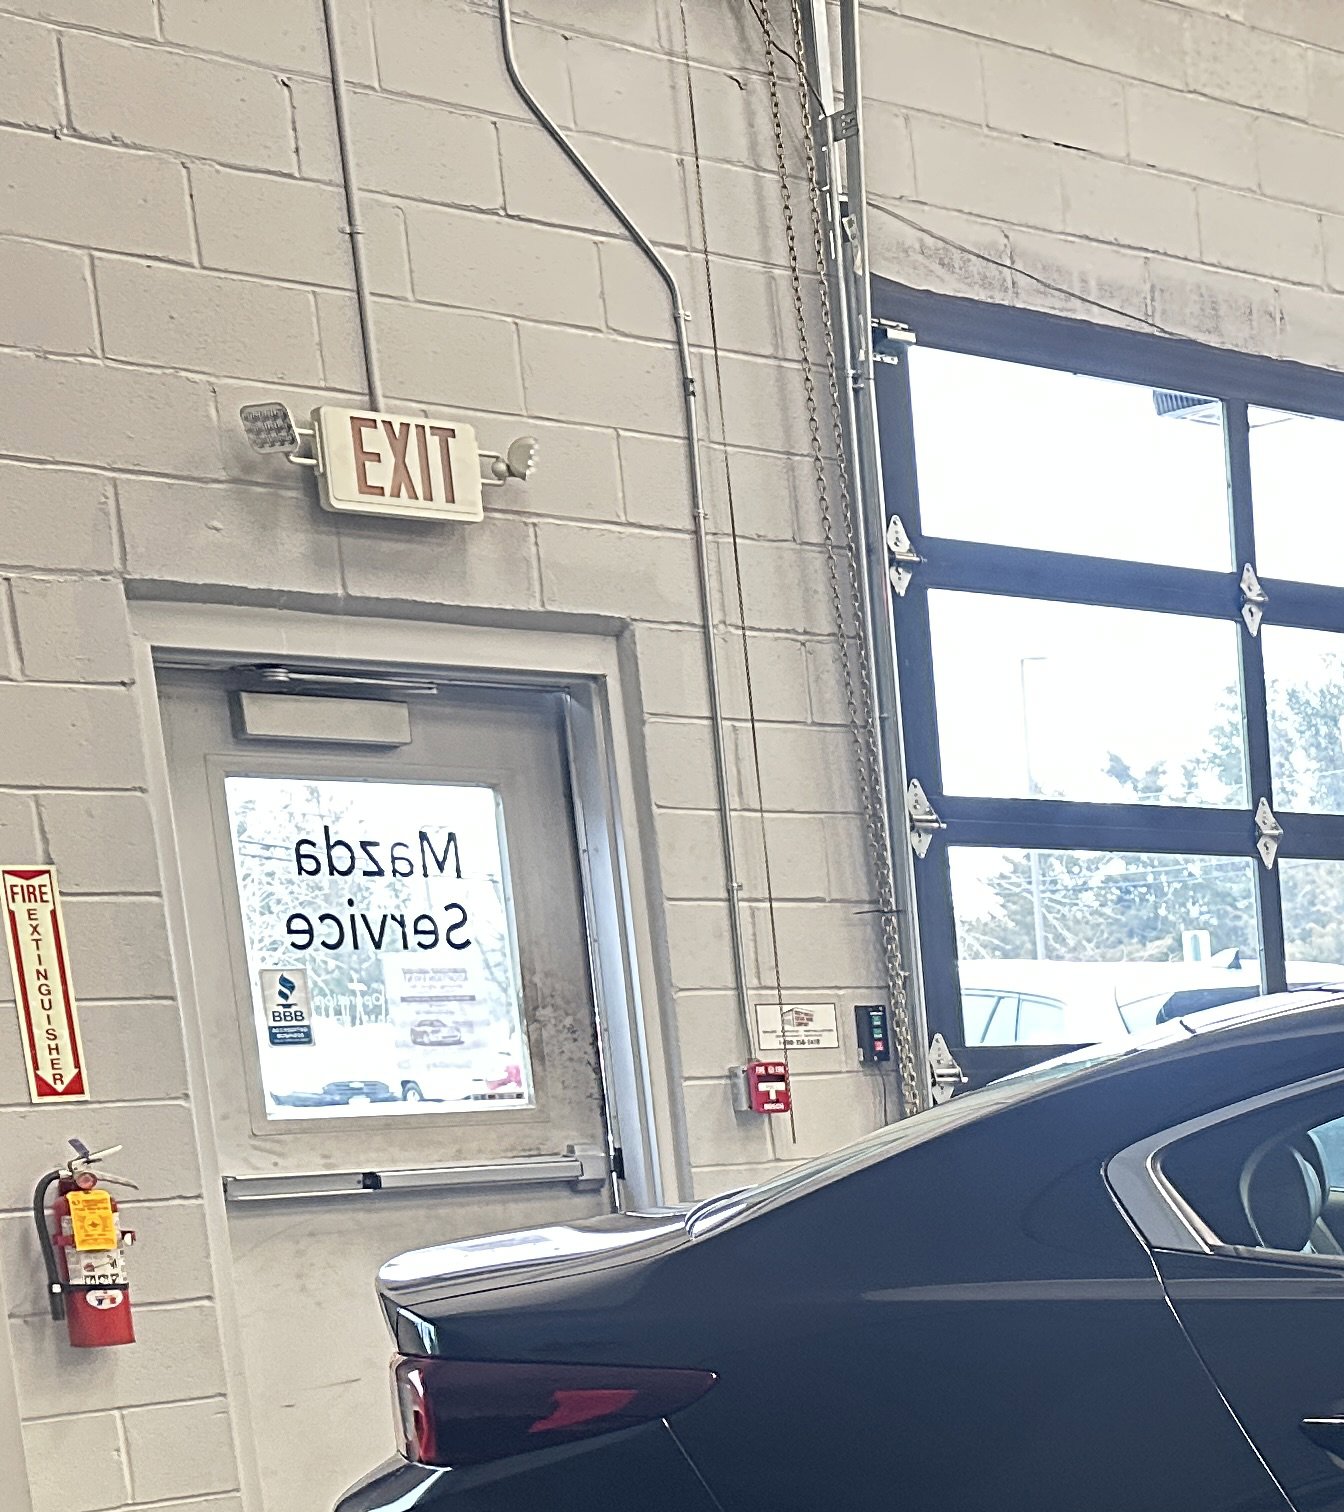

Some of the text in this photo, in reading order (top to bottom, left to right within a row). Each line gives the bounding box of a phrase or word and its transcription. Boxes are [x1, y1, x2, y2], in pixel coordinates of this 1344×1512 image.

[350, 416, 456, 504] EXIT
[10, 884, 49, 904] FIRE
[27, 908, 64, 1086] EXTINGUISHER
[272, 1010, 305, 1022] BBB
